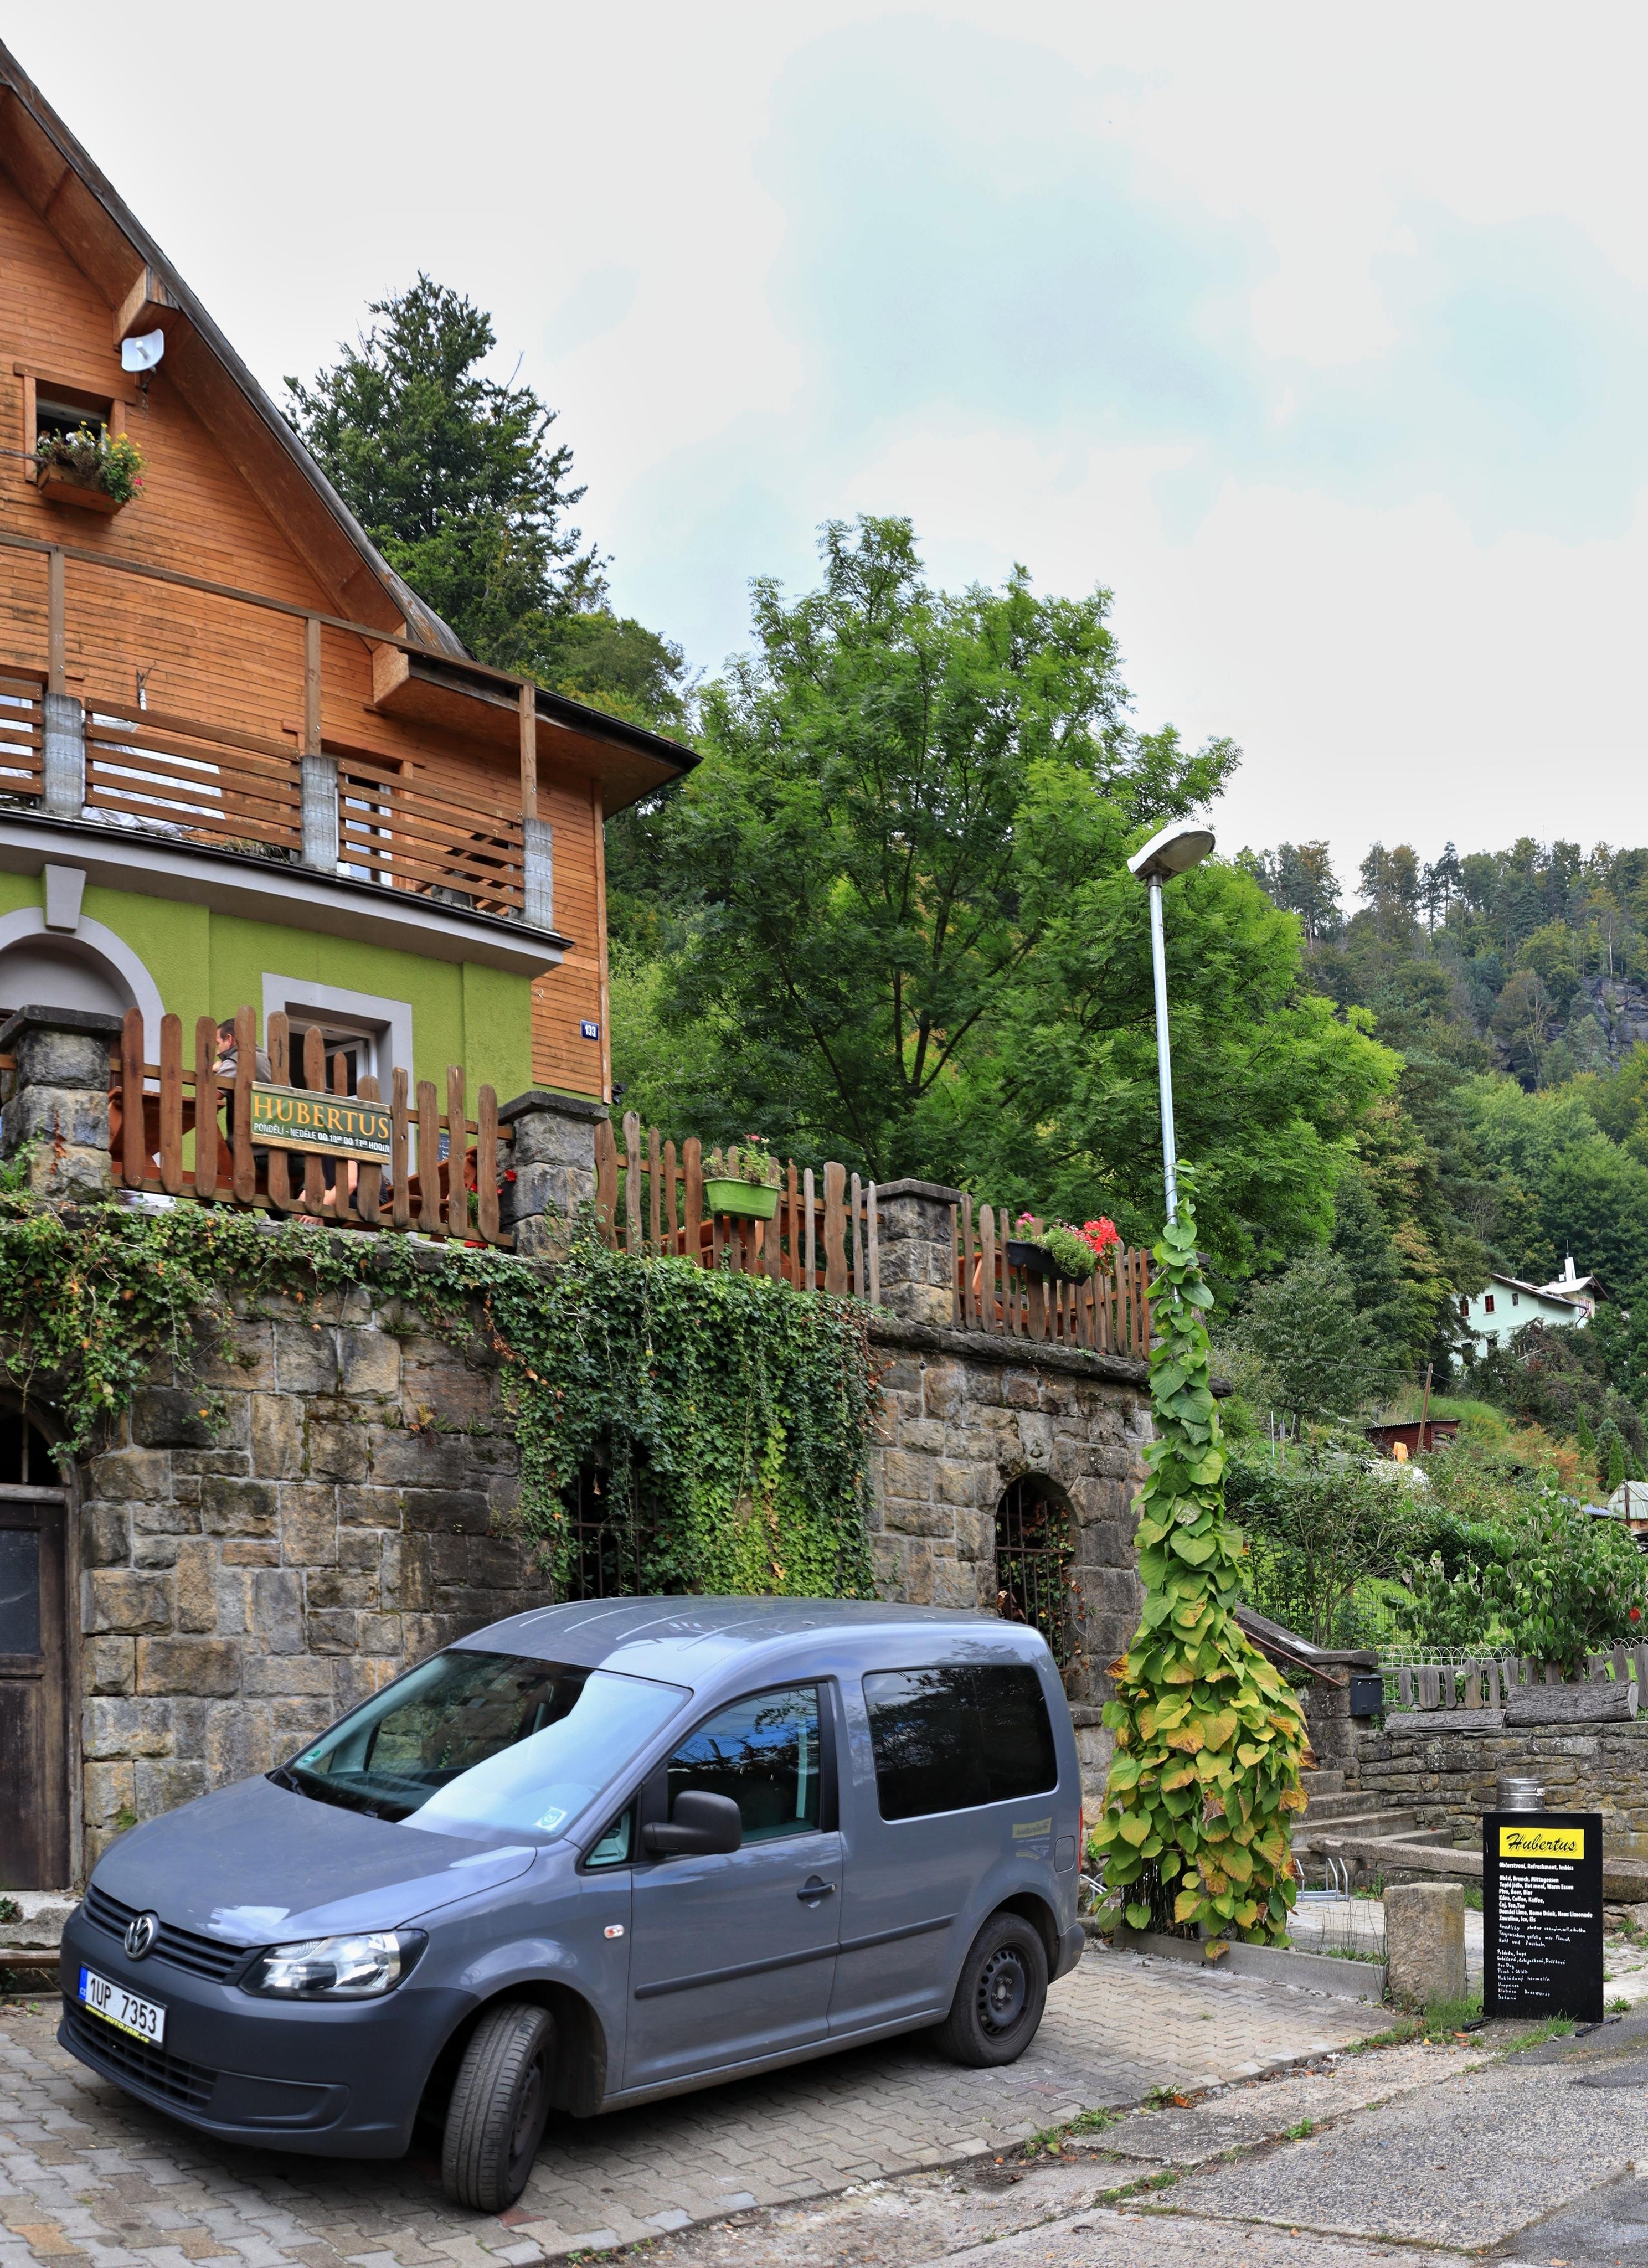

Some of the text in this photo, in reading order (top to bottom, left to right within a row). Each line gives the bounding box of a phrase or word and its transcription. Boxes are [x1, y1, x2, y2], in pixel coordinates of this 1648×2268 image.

[585, 1024, 596, 1038] 133
[253, 1095, 389, 1139] HUBERTUS
[254, 1122, 284, 1135] PONDĚLÍ
[290, 1128, 317, 1139] NEDĚLE
[318, 1132, 328, 1142] OD
[343, 1137, 354, 1146] DO
[369, 1141, 390, 1153] HODIN
[1506, 1833, 1577, 1852] Hubertus
[1527, 1863, 1558, 1871] Refreshment,
[91, 1977, 157, 2034] 1UP 7353
